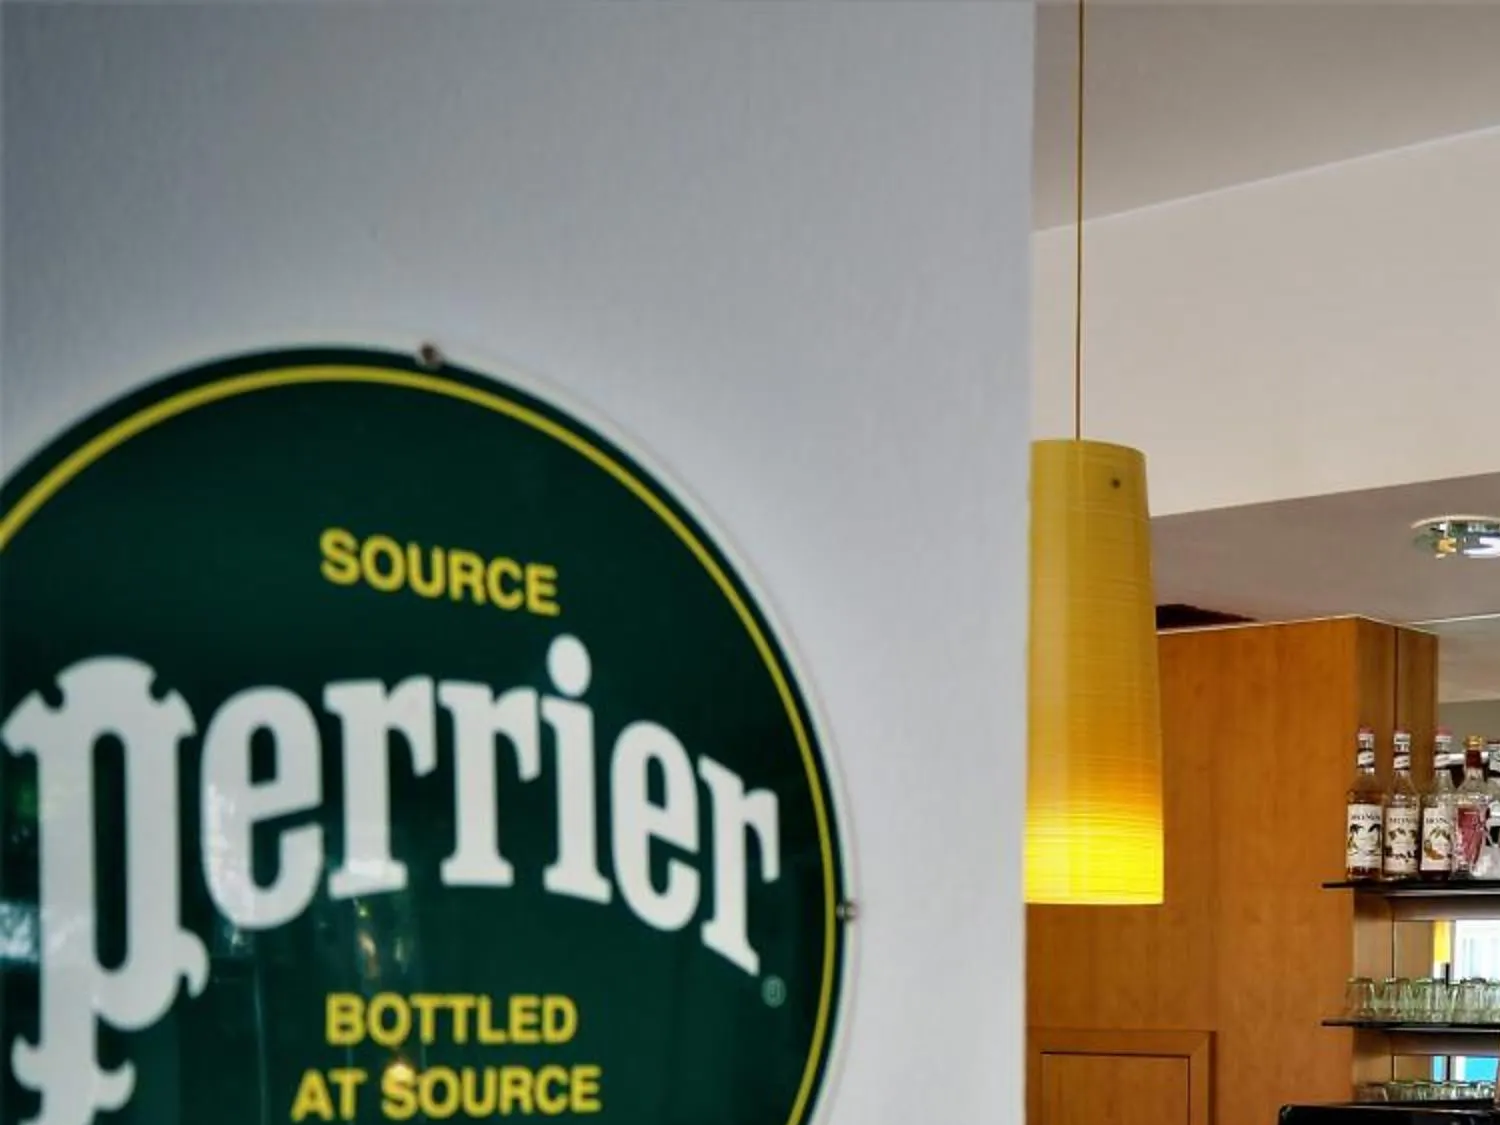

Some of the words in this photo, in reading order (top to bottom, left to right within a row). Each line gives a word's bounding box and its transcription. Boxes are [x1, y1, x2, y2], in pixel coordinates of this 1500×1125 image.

[320, 528, 560, 615] SOURCE
[326, 993, 577, 1047] BOTTLED
[291, 1068, 366, 1121] AT
[381, 1065, 601, 1116] SOURCE
